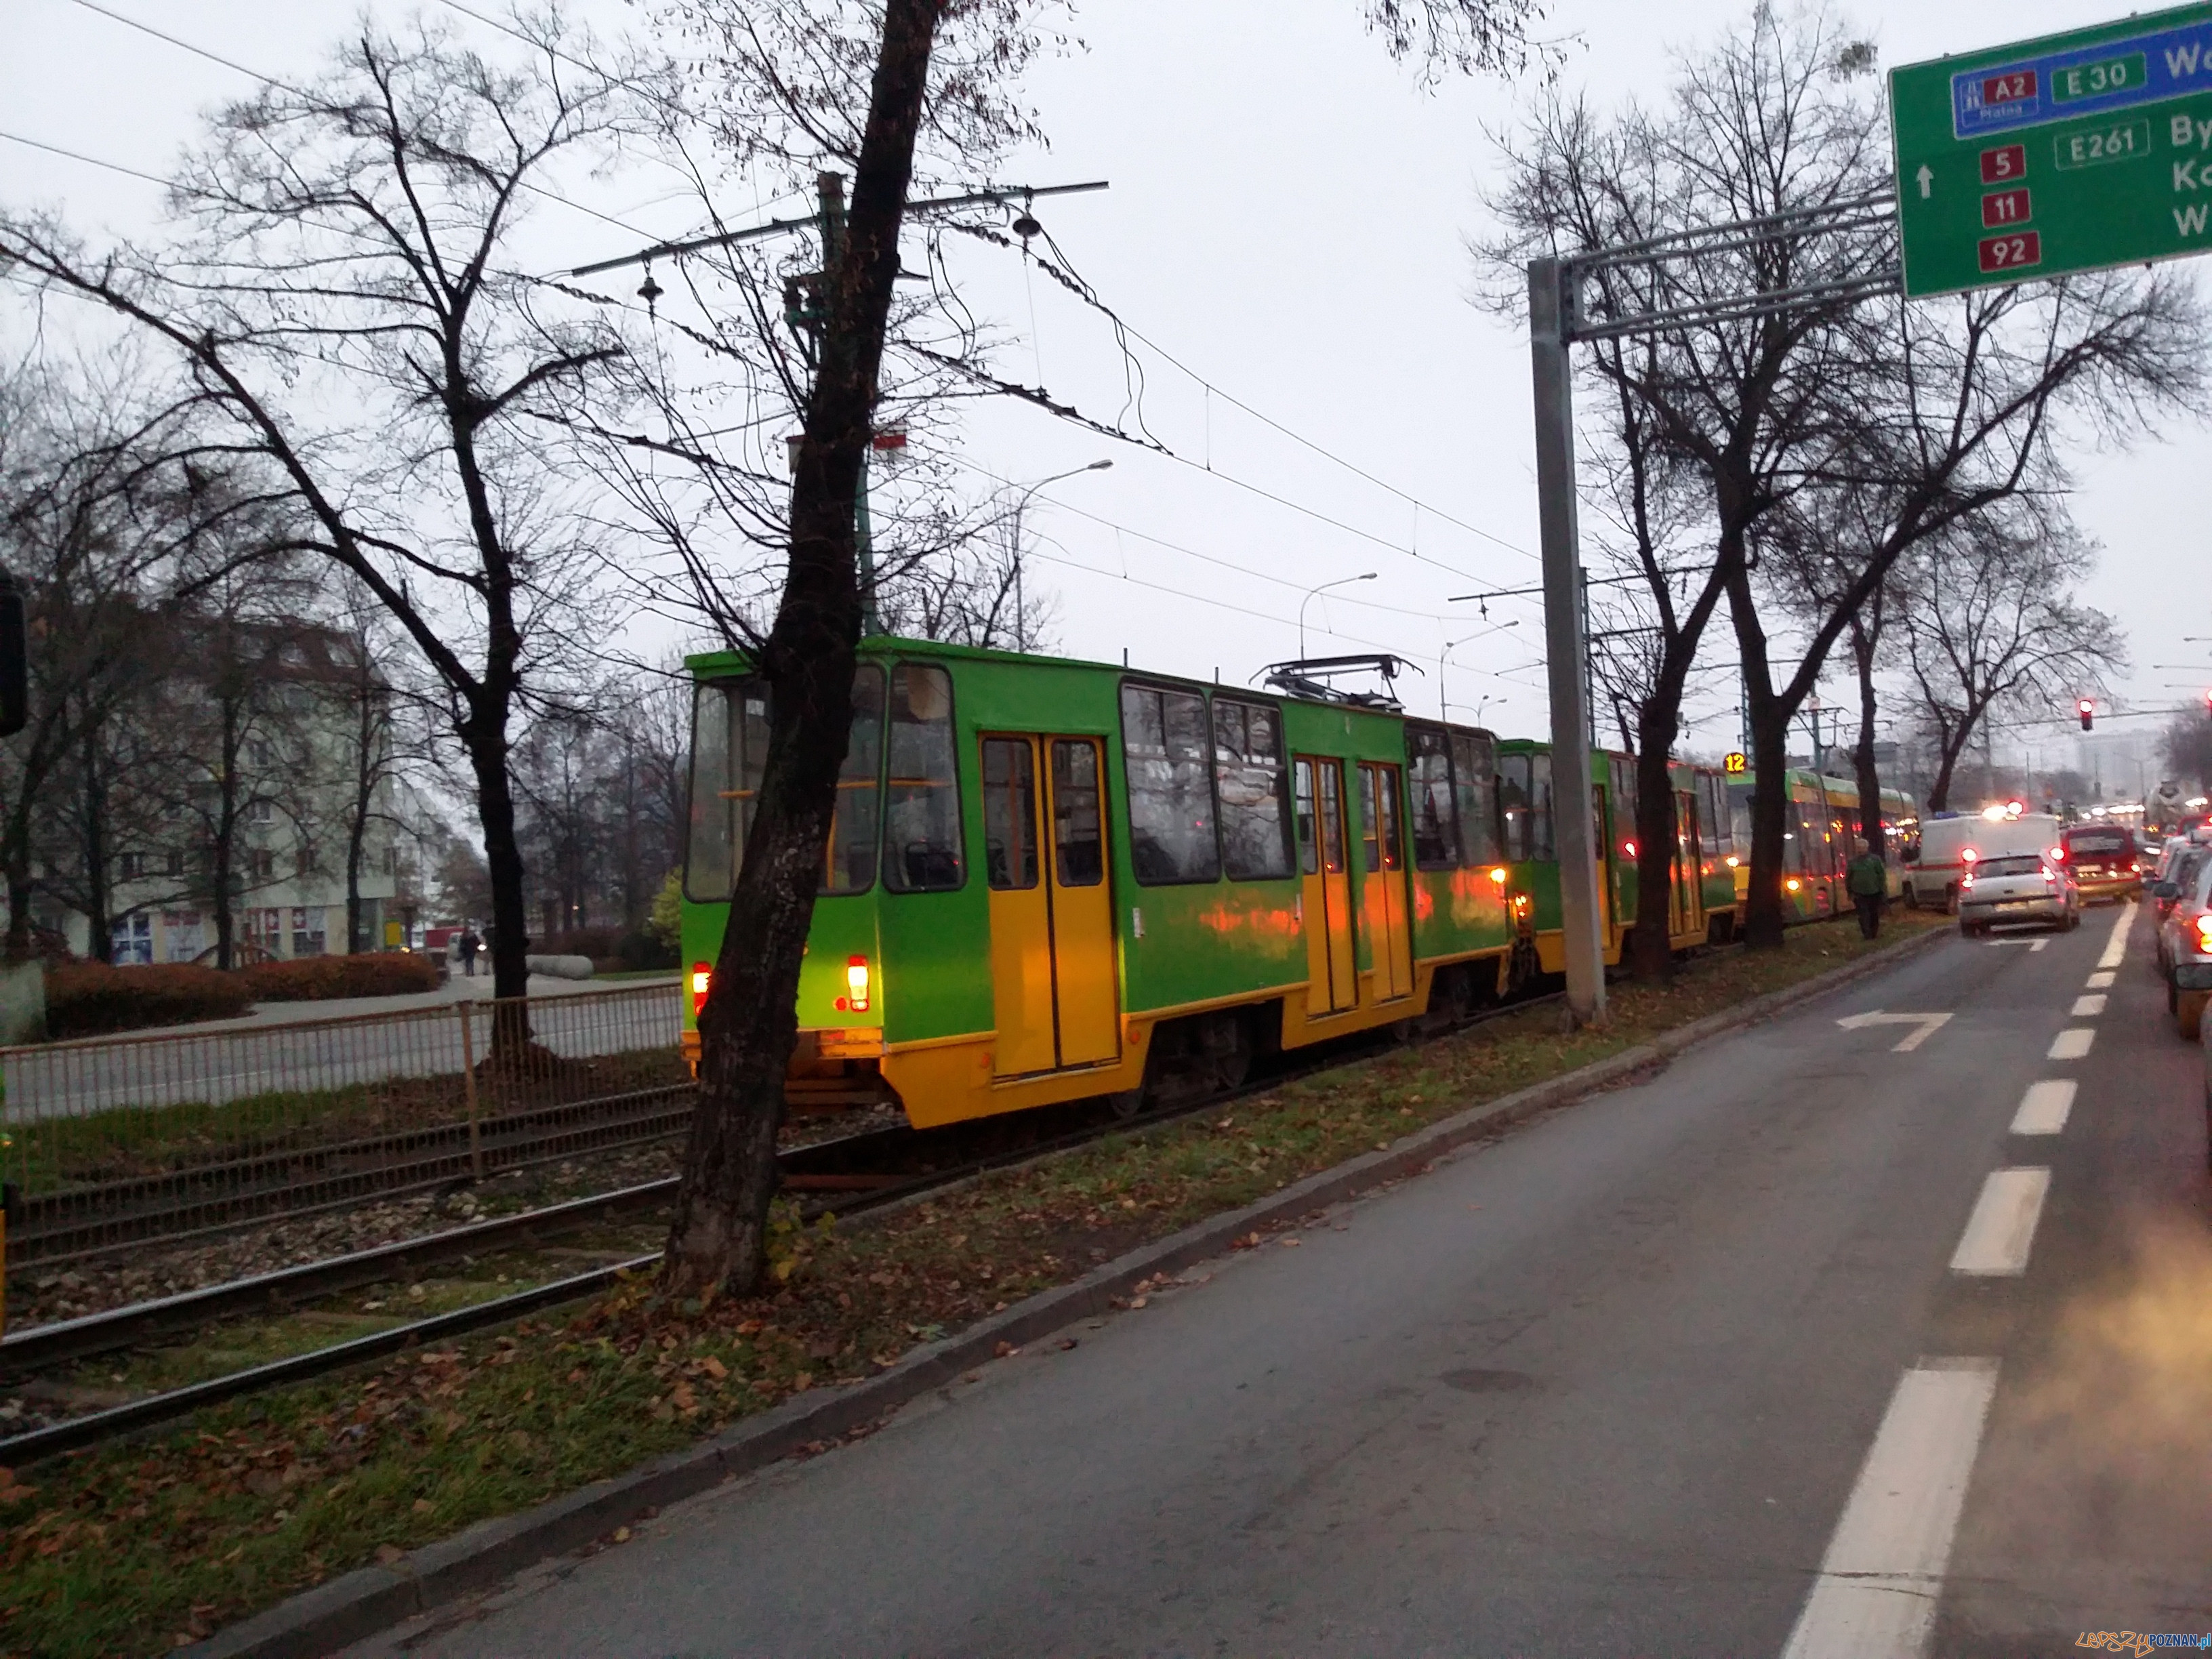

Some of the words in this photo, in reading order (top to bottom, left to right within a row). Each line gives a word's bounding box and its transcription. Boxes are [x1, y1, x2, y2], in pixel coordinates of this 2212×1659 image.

[1995, 76, 2025, 101] A2
[2071, 128, 2134, 161] E261
[1996, 153, 2011, 176] 5
[1995, 197, 2016, 220] 11
[1992, 239, 2026, 266] 92
[1725, 754, 1745, 771] 12
